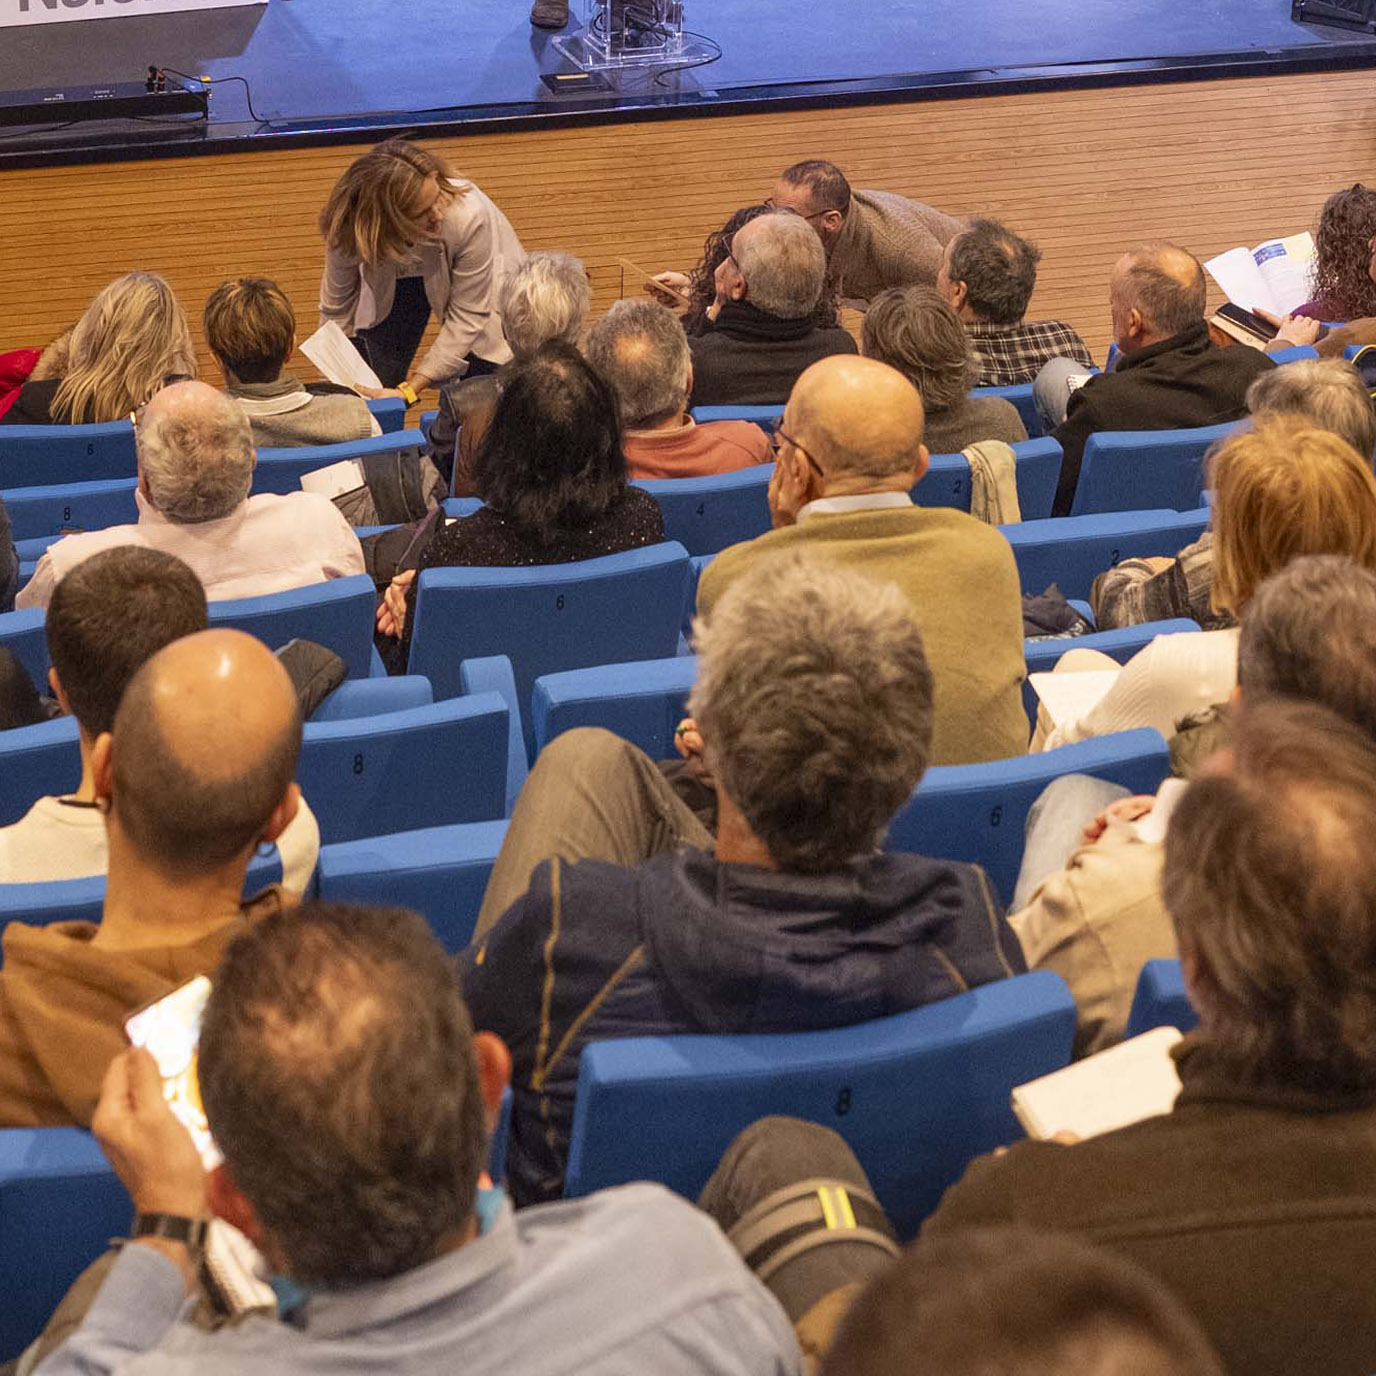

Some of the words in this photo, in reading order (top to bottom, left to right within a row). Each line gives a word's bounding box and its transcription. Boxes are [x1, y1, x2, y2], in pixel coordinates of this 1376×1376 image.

[953, 479, 963, 495] 2
[63, 506, 72, 522] 8
[696, 502, 706, 517] 4
[555, 594, 566, 611] 6
[352, 752, 365, 775] 8
[990, 805, 1003, 827] 6
[836, 1086, 854, 1116] 8
